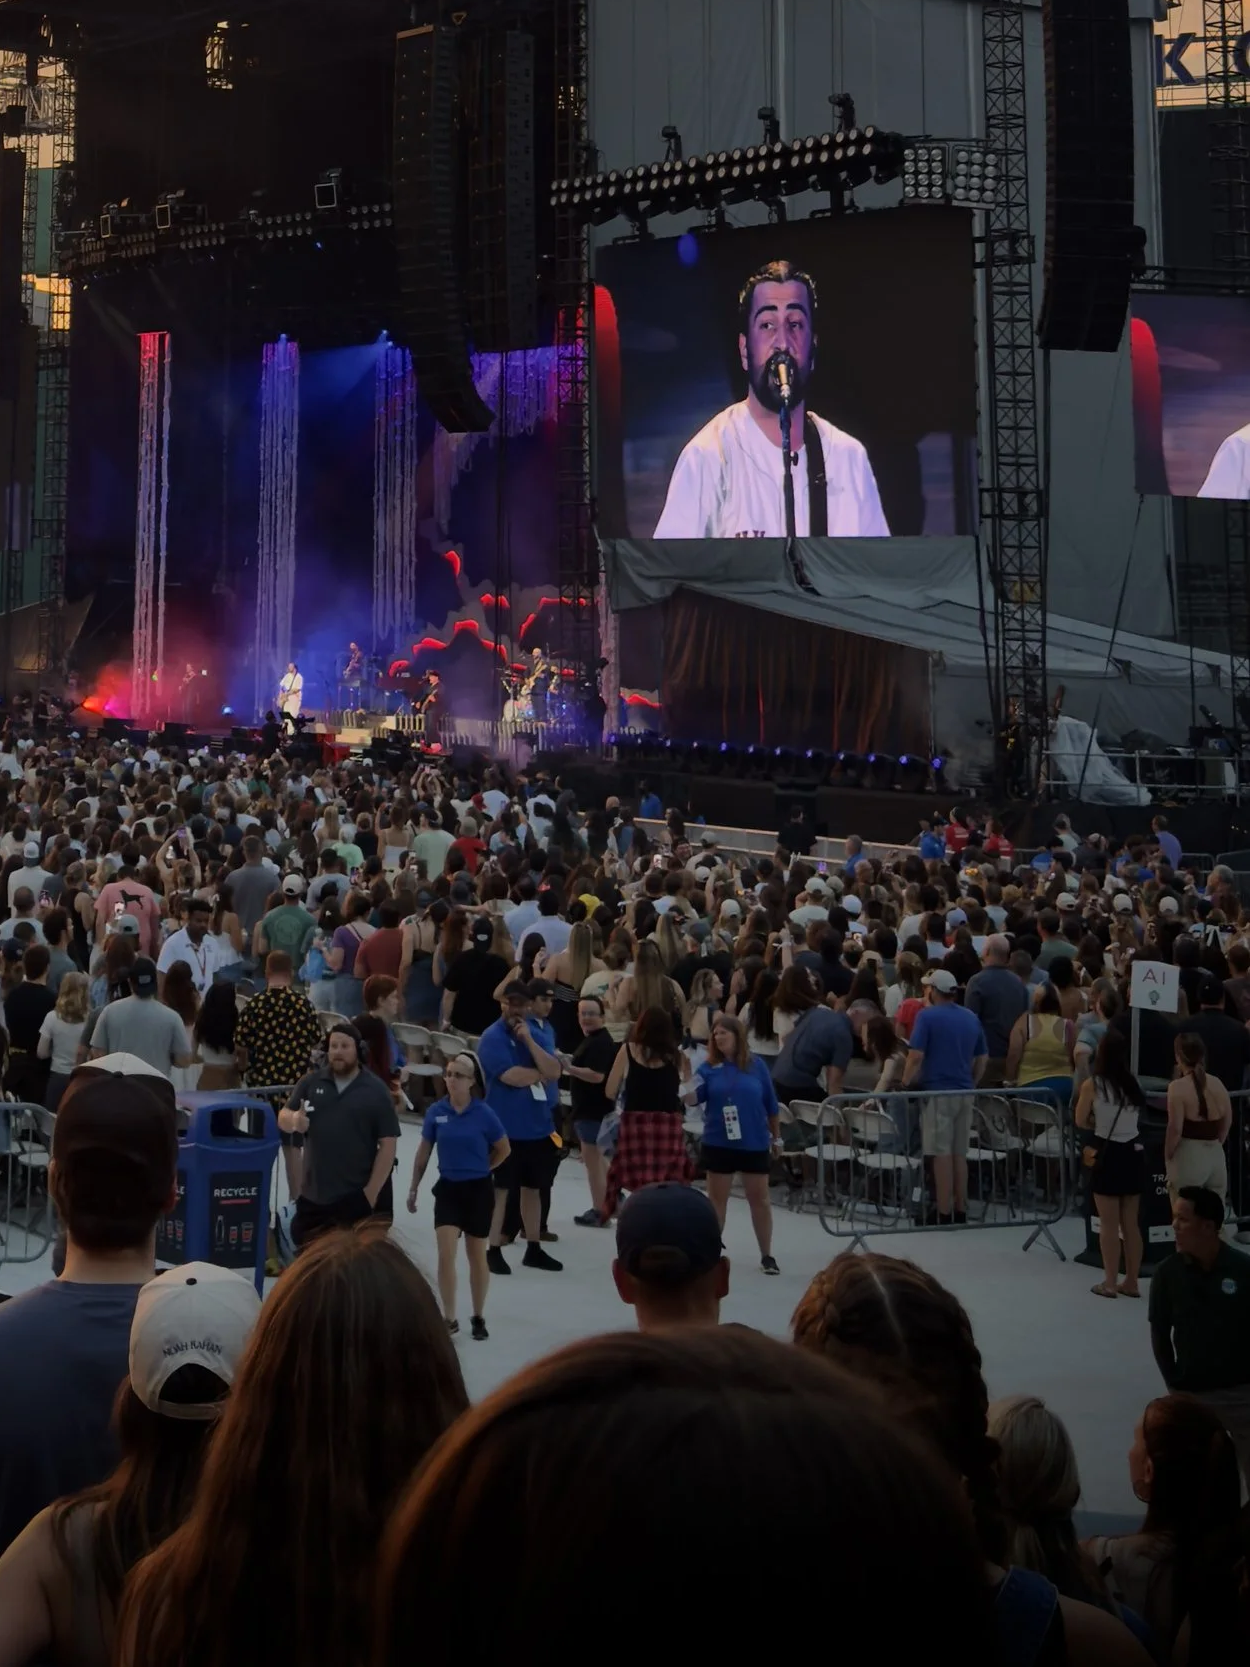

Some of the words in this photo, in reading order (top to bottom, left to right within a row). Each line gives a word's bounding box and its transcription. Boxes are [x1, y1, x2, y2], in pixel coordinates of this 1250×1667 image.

[213, 1186, 258, 1197] RECYCLE
[162, 1341, 188, 1358] NOAH
[190, 1340, 223, 1354] KAHAN
